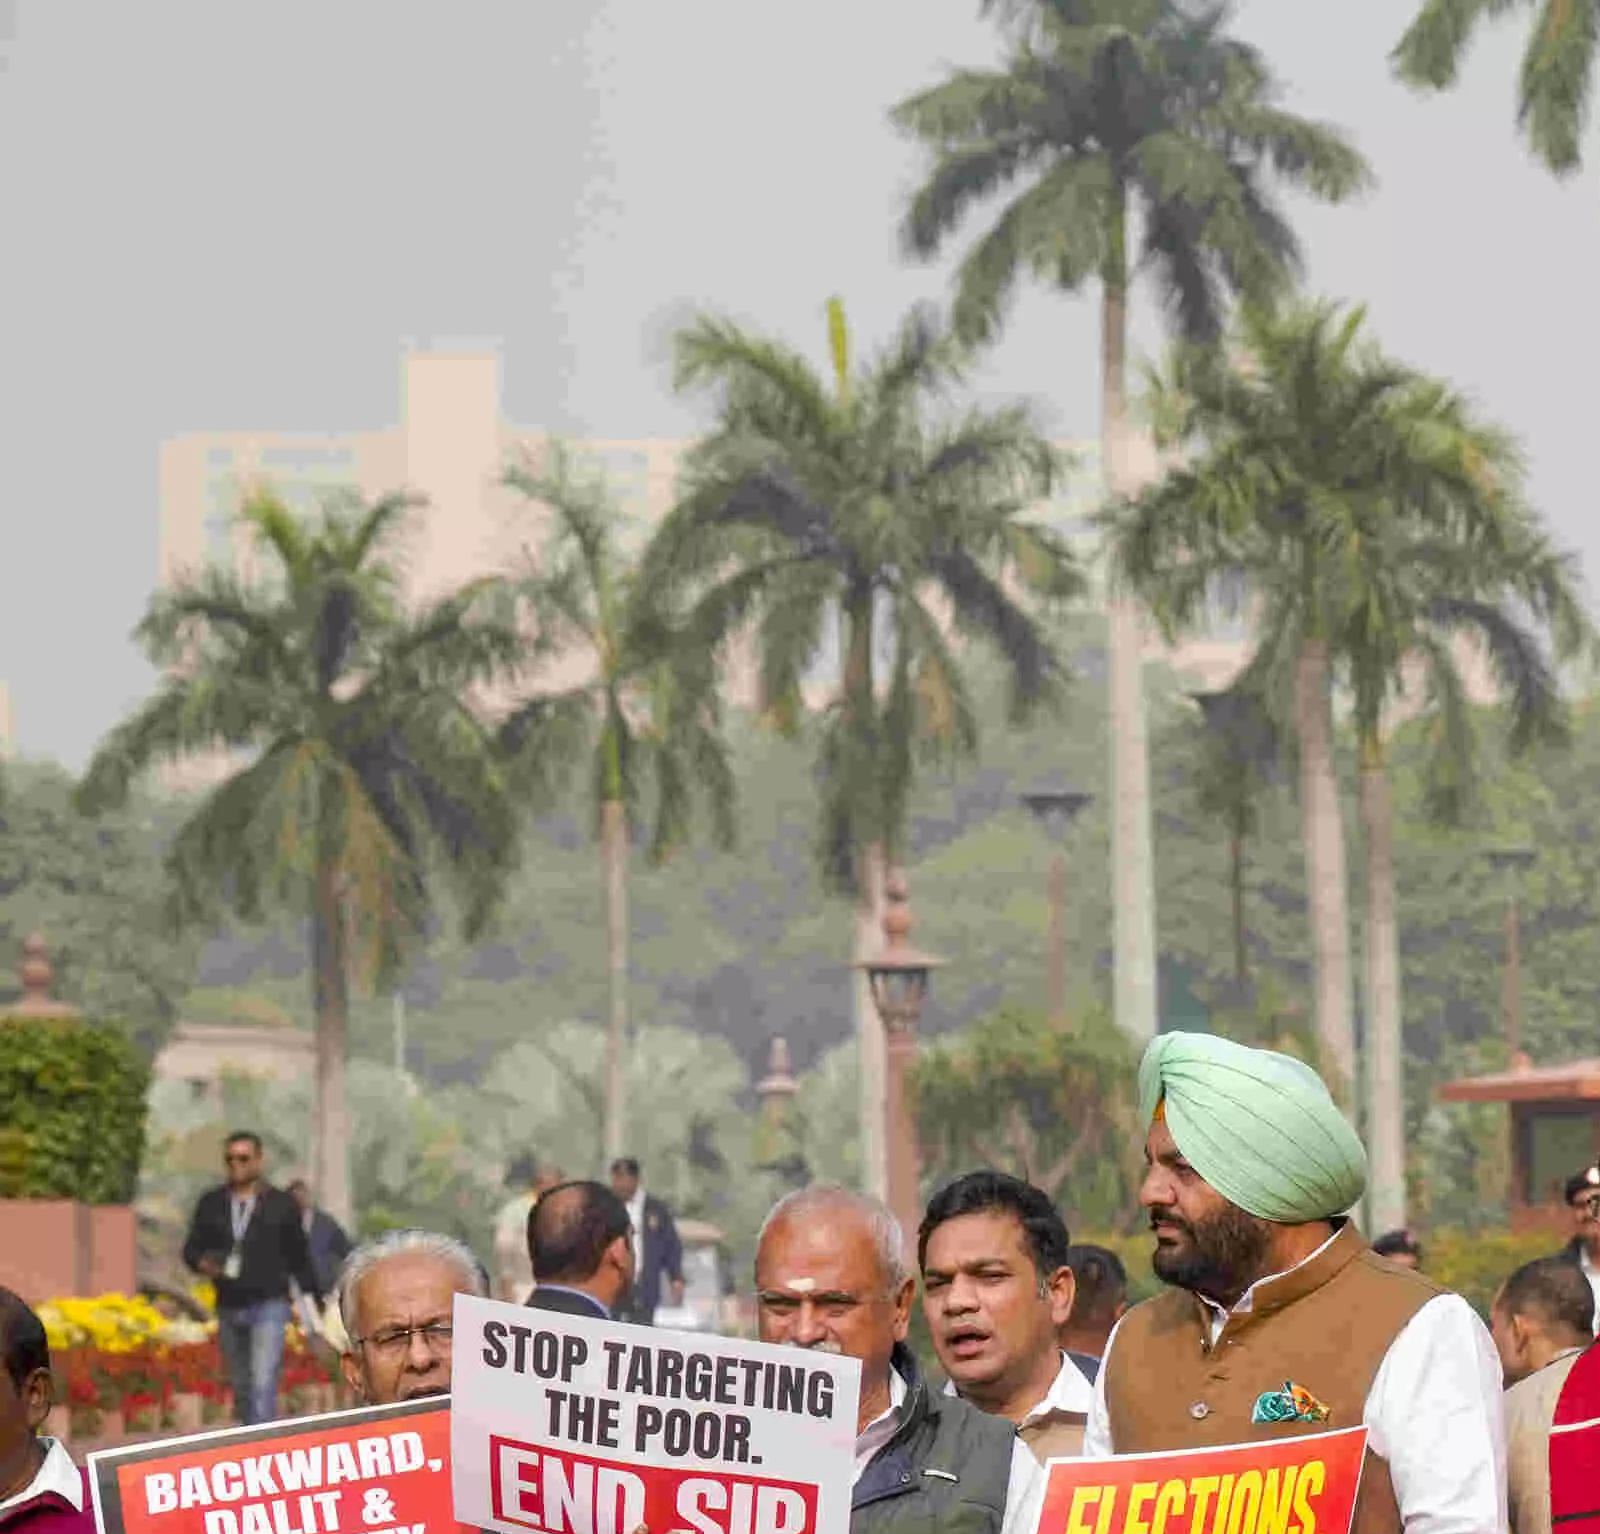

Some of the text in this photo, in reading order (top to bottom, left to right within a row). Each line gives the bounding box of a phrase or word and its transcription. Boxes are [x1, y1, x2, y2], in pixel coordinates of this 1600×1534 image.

[482, 1320, 834, 1419] STOP TARGETING
[545, 1388, 762, 1464] THE POOR.
[144, 1431, 444, 1515] BACKWARD,
[361, 1487, 396, 1525] &
